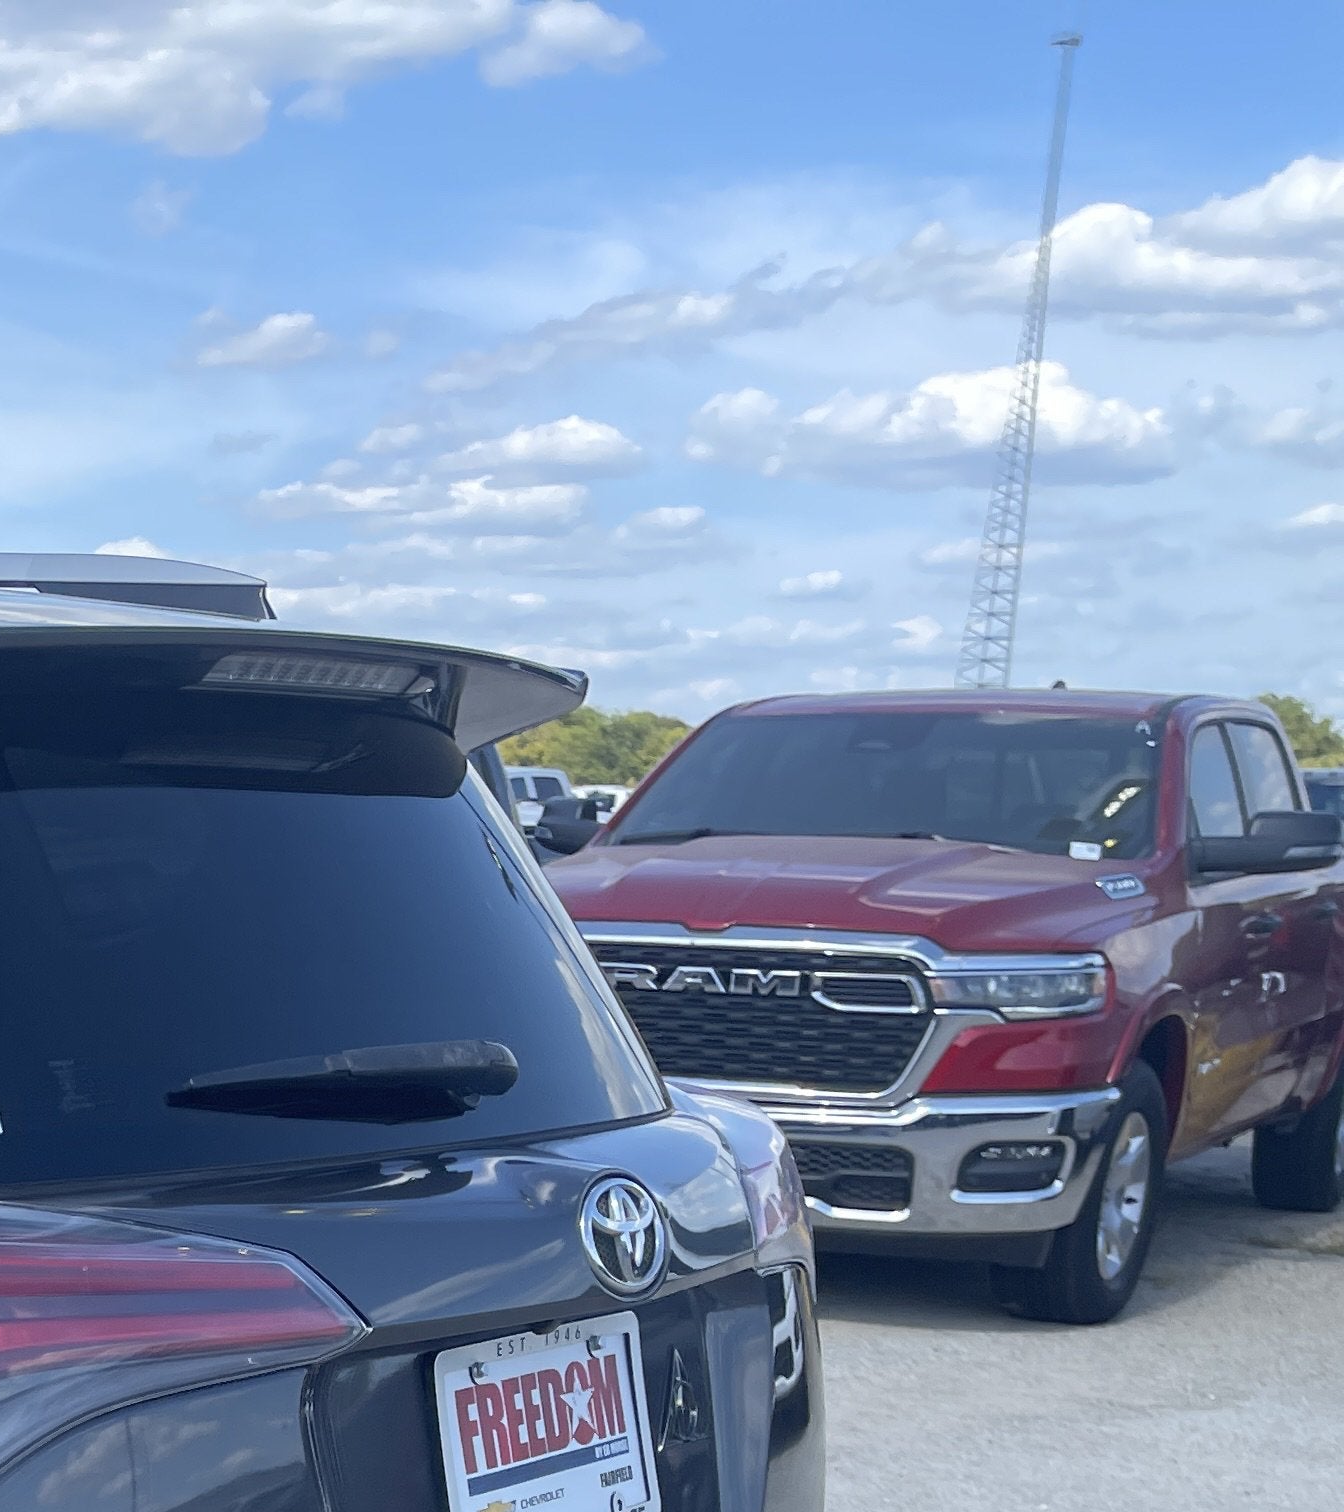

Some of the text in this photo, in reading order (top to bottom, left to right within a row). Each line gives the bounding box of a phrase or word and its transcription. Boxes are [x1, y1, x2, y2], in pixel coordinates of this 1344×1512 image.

[598, 961, 801, 997] RAM
[545, 1325, 581, 1346] 1946
[454, 1354, 627, 1475] FREEDOM
[520, 1488, 565, 1510] CHEVROLET
